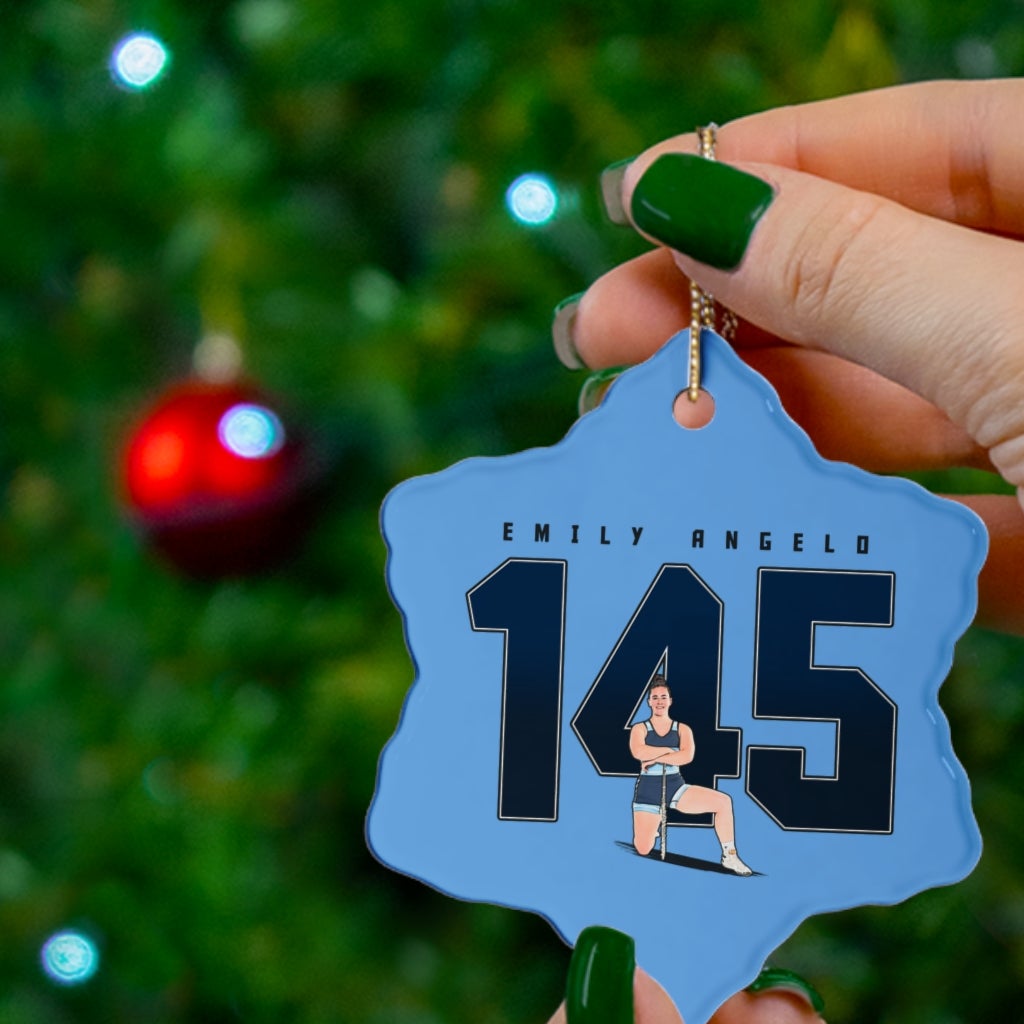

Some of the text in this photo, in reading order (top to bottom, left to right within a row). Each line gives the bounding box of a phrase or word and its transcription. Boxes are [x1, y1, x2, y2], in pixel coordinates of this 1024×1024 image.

[503, 522, 869, 554] EMILY ANGELO
[466, 557, 898, 834] 145
